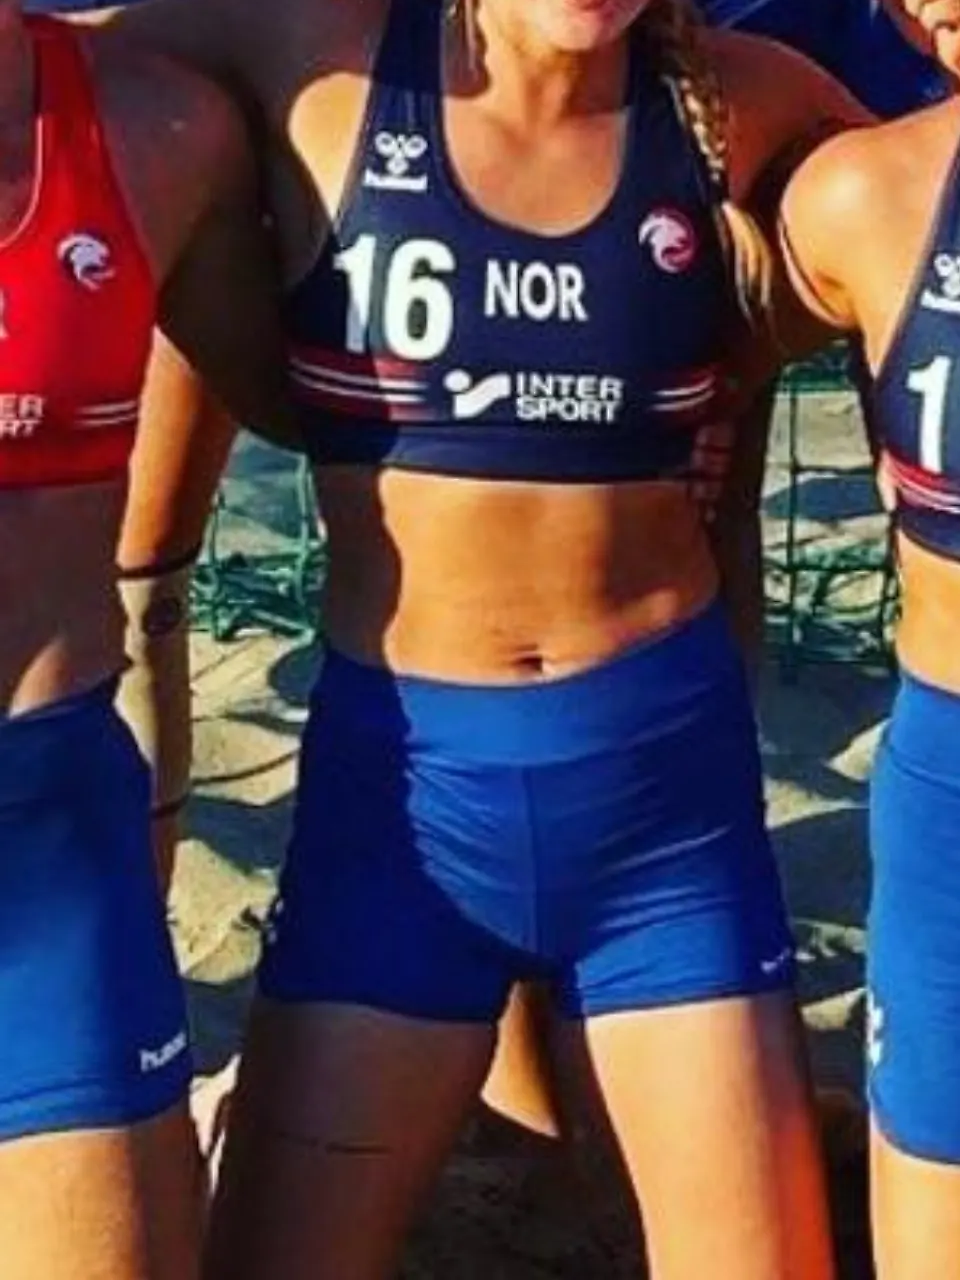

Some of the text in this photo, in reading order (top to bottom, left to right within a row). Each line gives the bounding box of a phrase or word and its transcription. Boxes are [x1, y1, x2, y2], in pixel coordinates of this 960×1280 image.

[333, 233, 456, 360] 16
[484, 259, 588, 321] NOR
[515, 371, 625, 399] INTER
[515, 396, 623, 423] SPORT
[907, 355, 952, 474] 1
